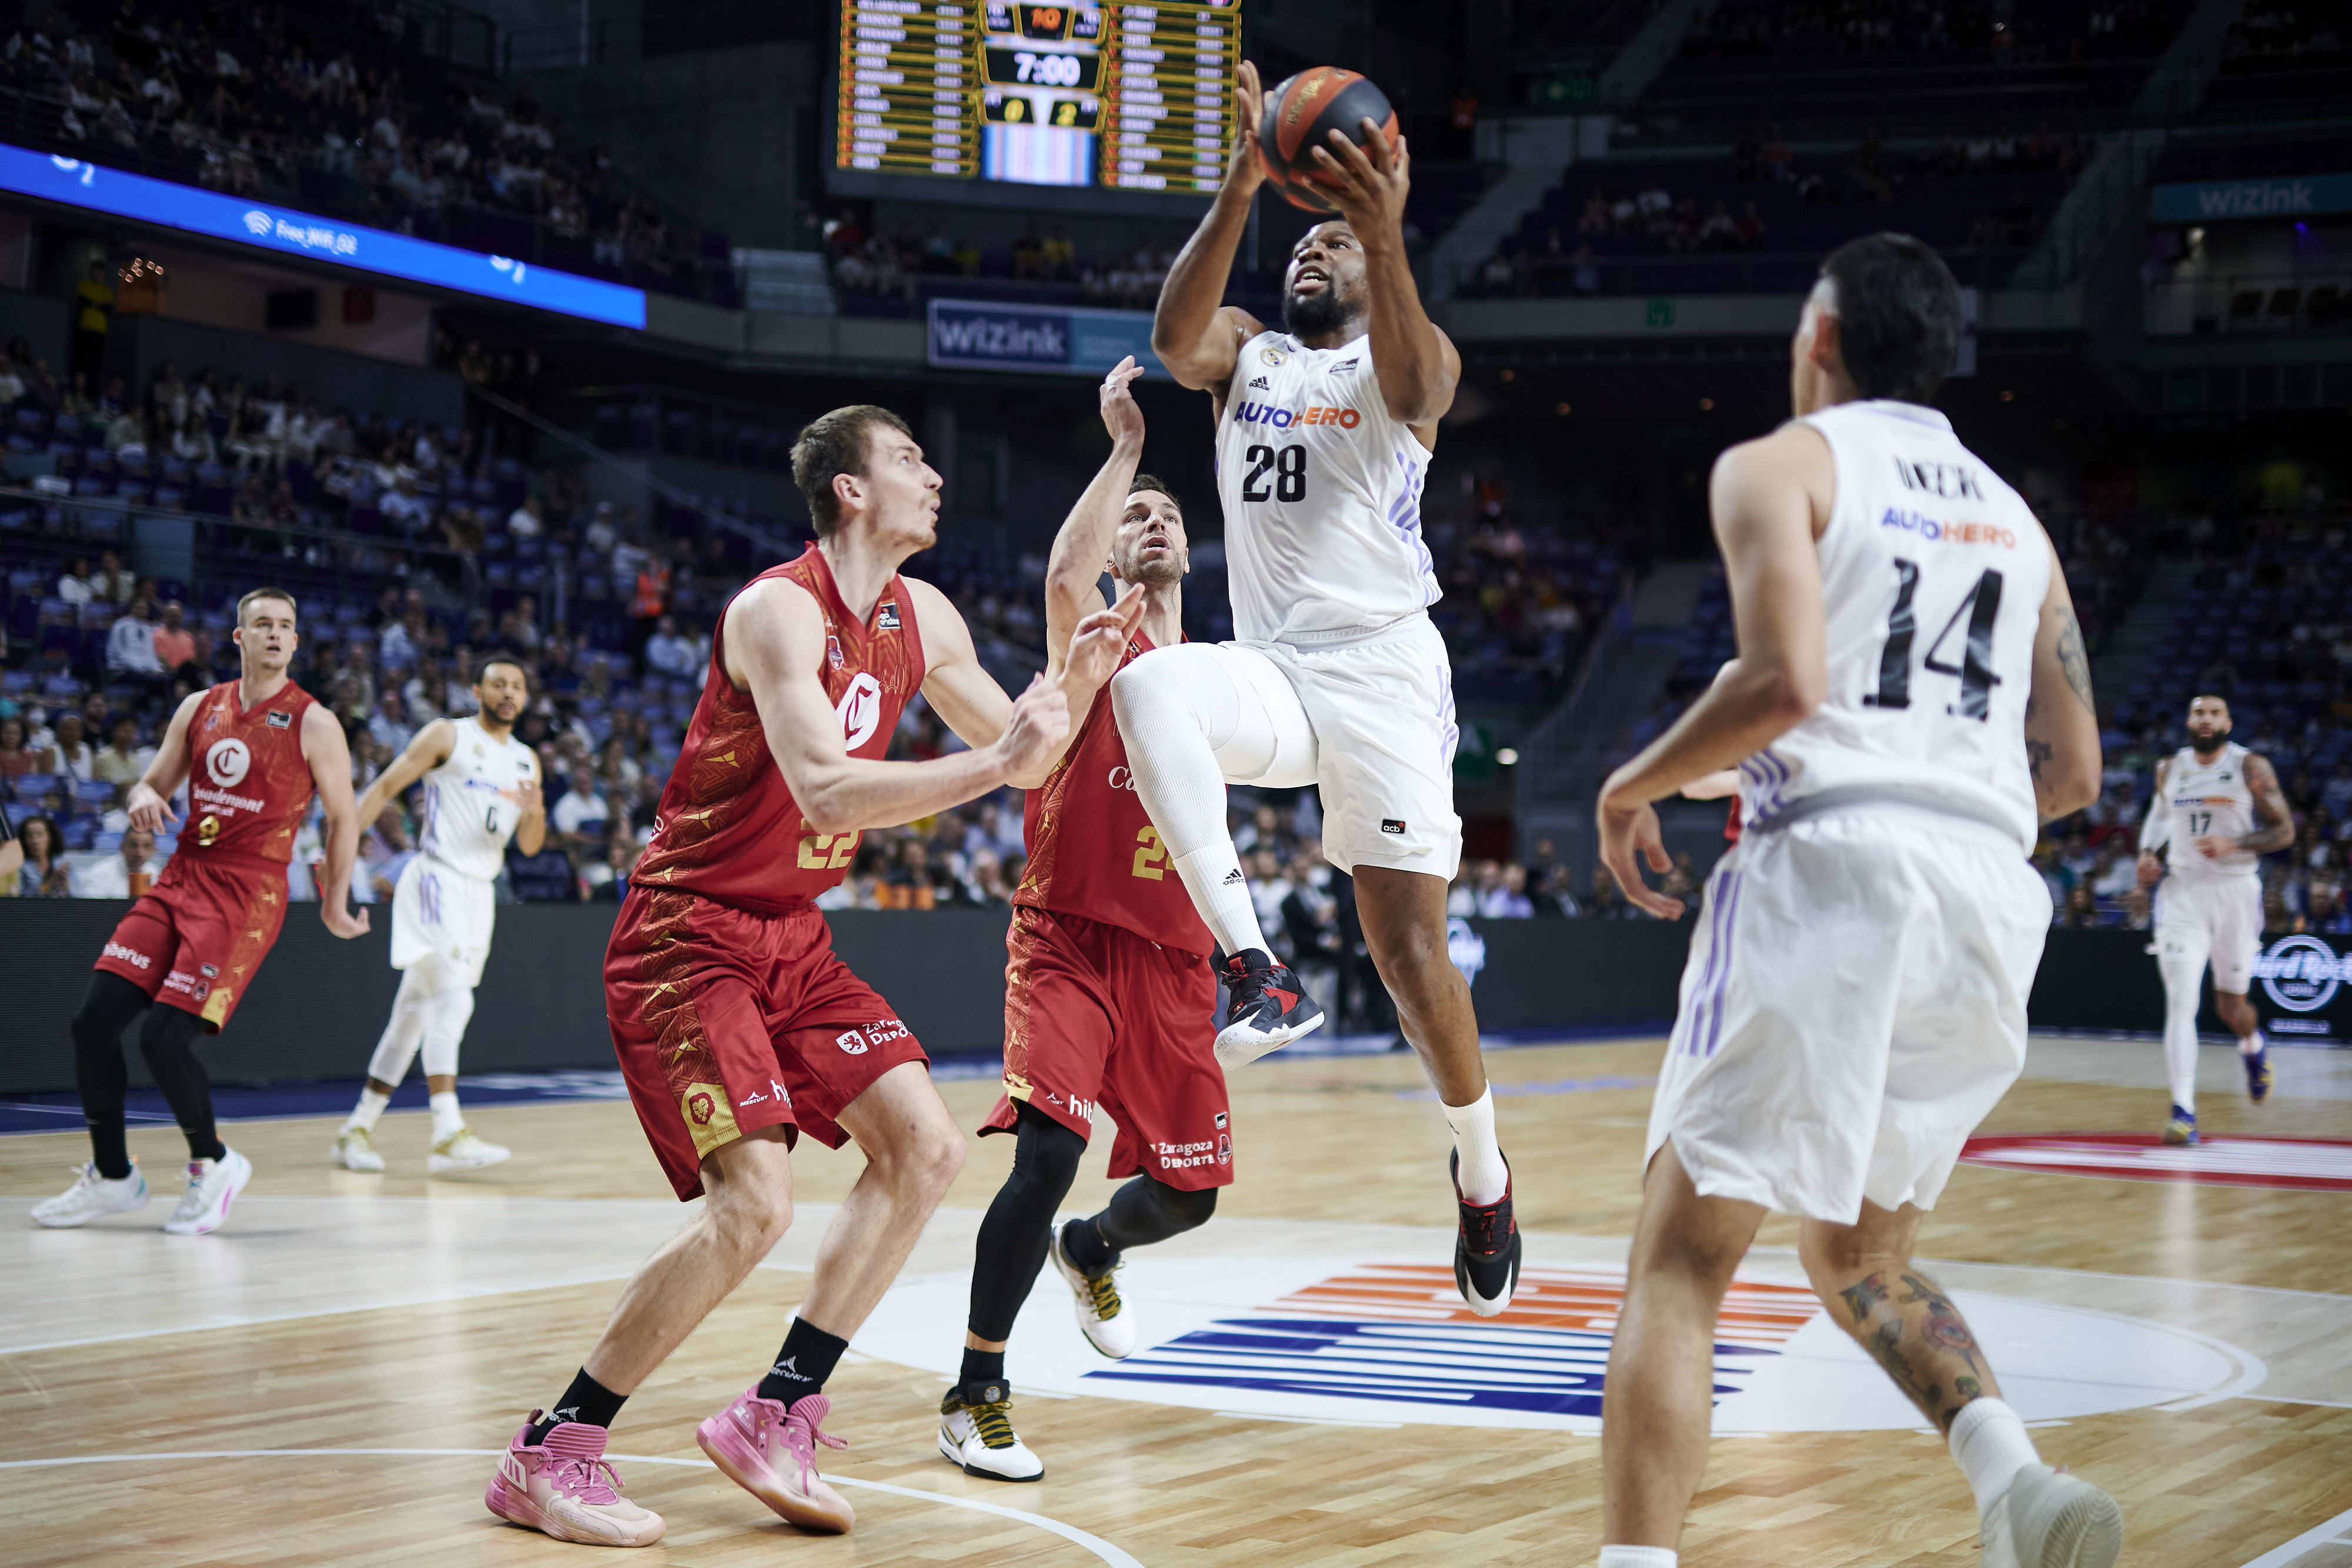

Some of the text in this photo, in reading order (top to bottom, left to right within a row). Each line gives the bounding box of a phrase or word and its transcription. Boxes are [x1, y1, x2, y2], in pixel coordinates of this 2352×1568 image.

[1014, 52, 1081, 86] 7:00
[1248, 382, 1270, 391] adidas
[1234, 401, 1361, 429] AUTOHERO
[1243, 444, 1307, 502] 28
[1862, 557, 2003, 723] 14
[2189, 809, 2212, 835] 17
[740, 1095, 769, 1106] MERCURY
[1158, 1141, 1214, 1156] Zaragoza
[1161, 1154, 1215, 1169] DEPORTE
